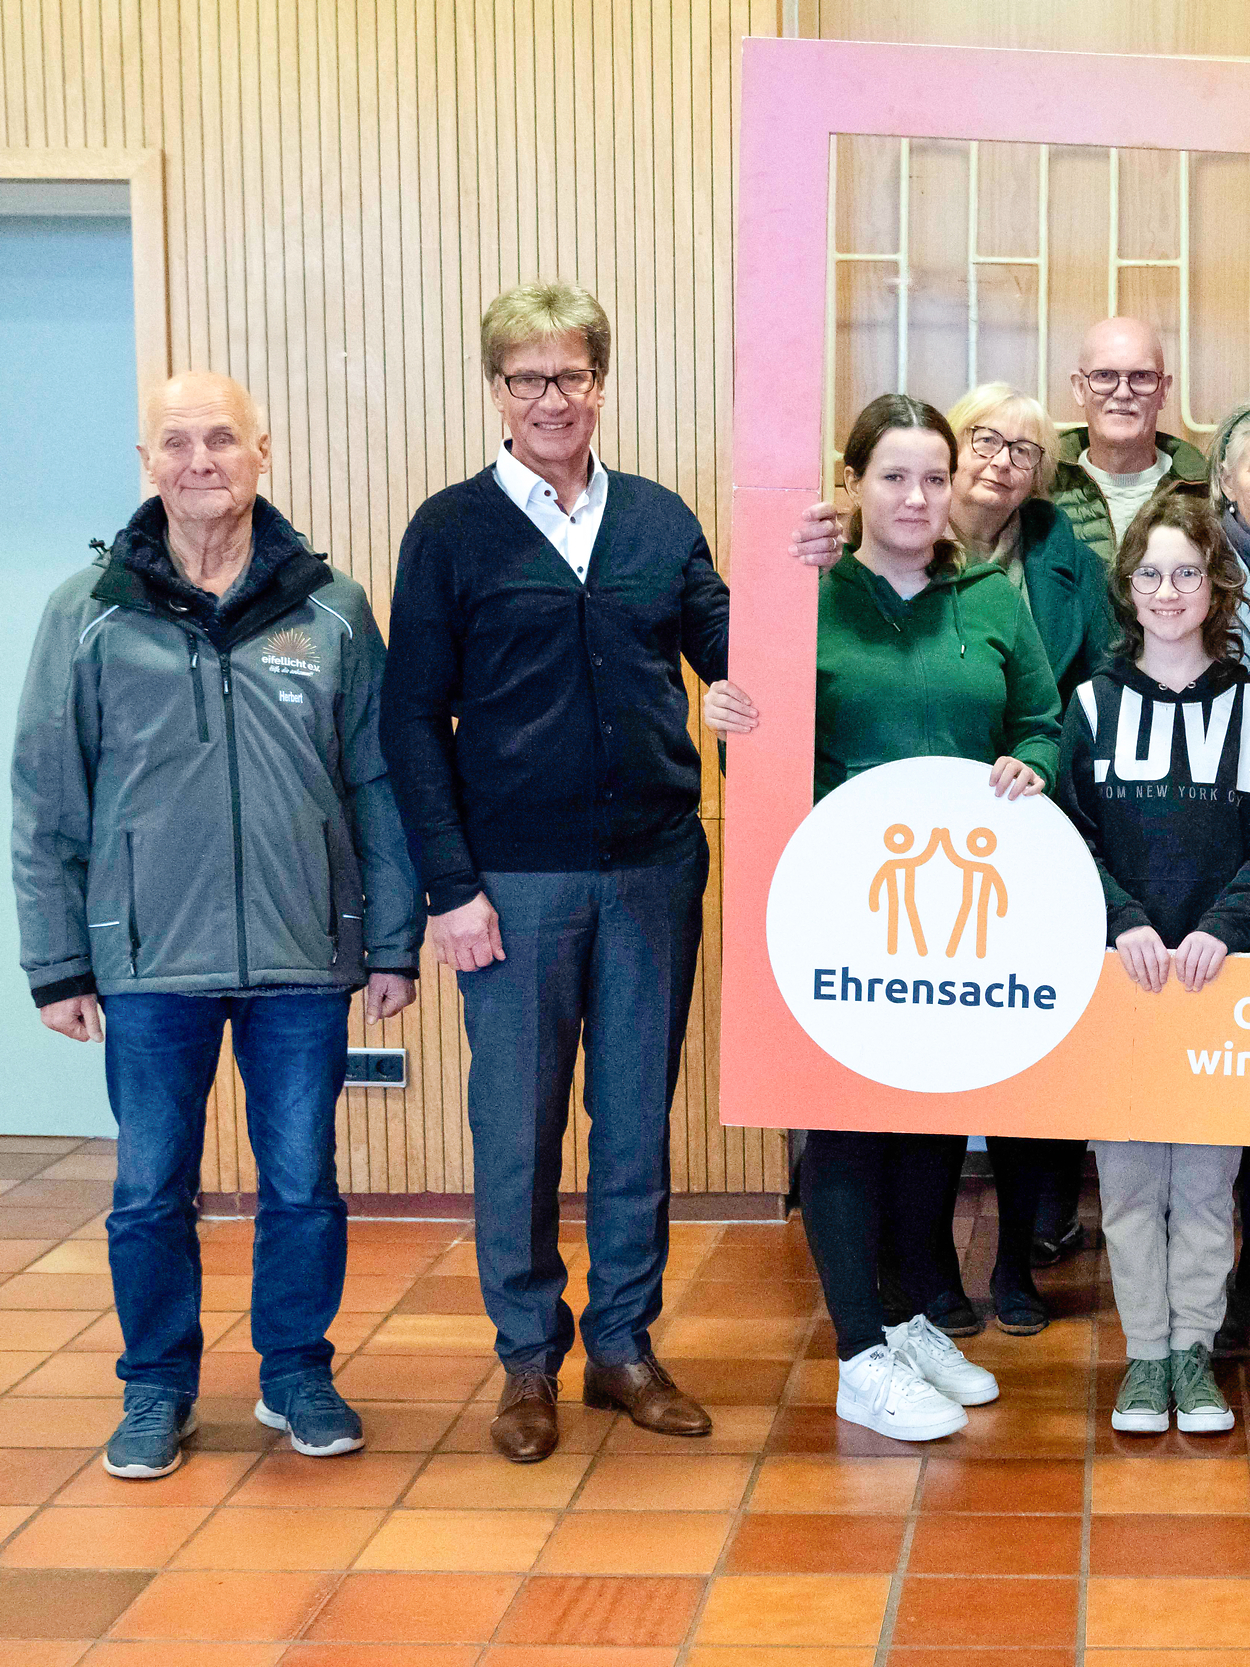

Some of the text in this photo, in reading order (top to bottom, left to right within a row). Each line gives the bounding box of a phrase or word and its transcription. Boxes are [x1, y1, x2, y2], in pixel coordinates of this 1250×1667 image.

[261, 655, 307, 669] eifellicht
[279, 690, 303, 703] Herbert
[1136, 784, 1169, 799] NEW
[1178, 786, 1219, 801] YORK
[813, 966, 1057, 1010] Ehrensache
